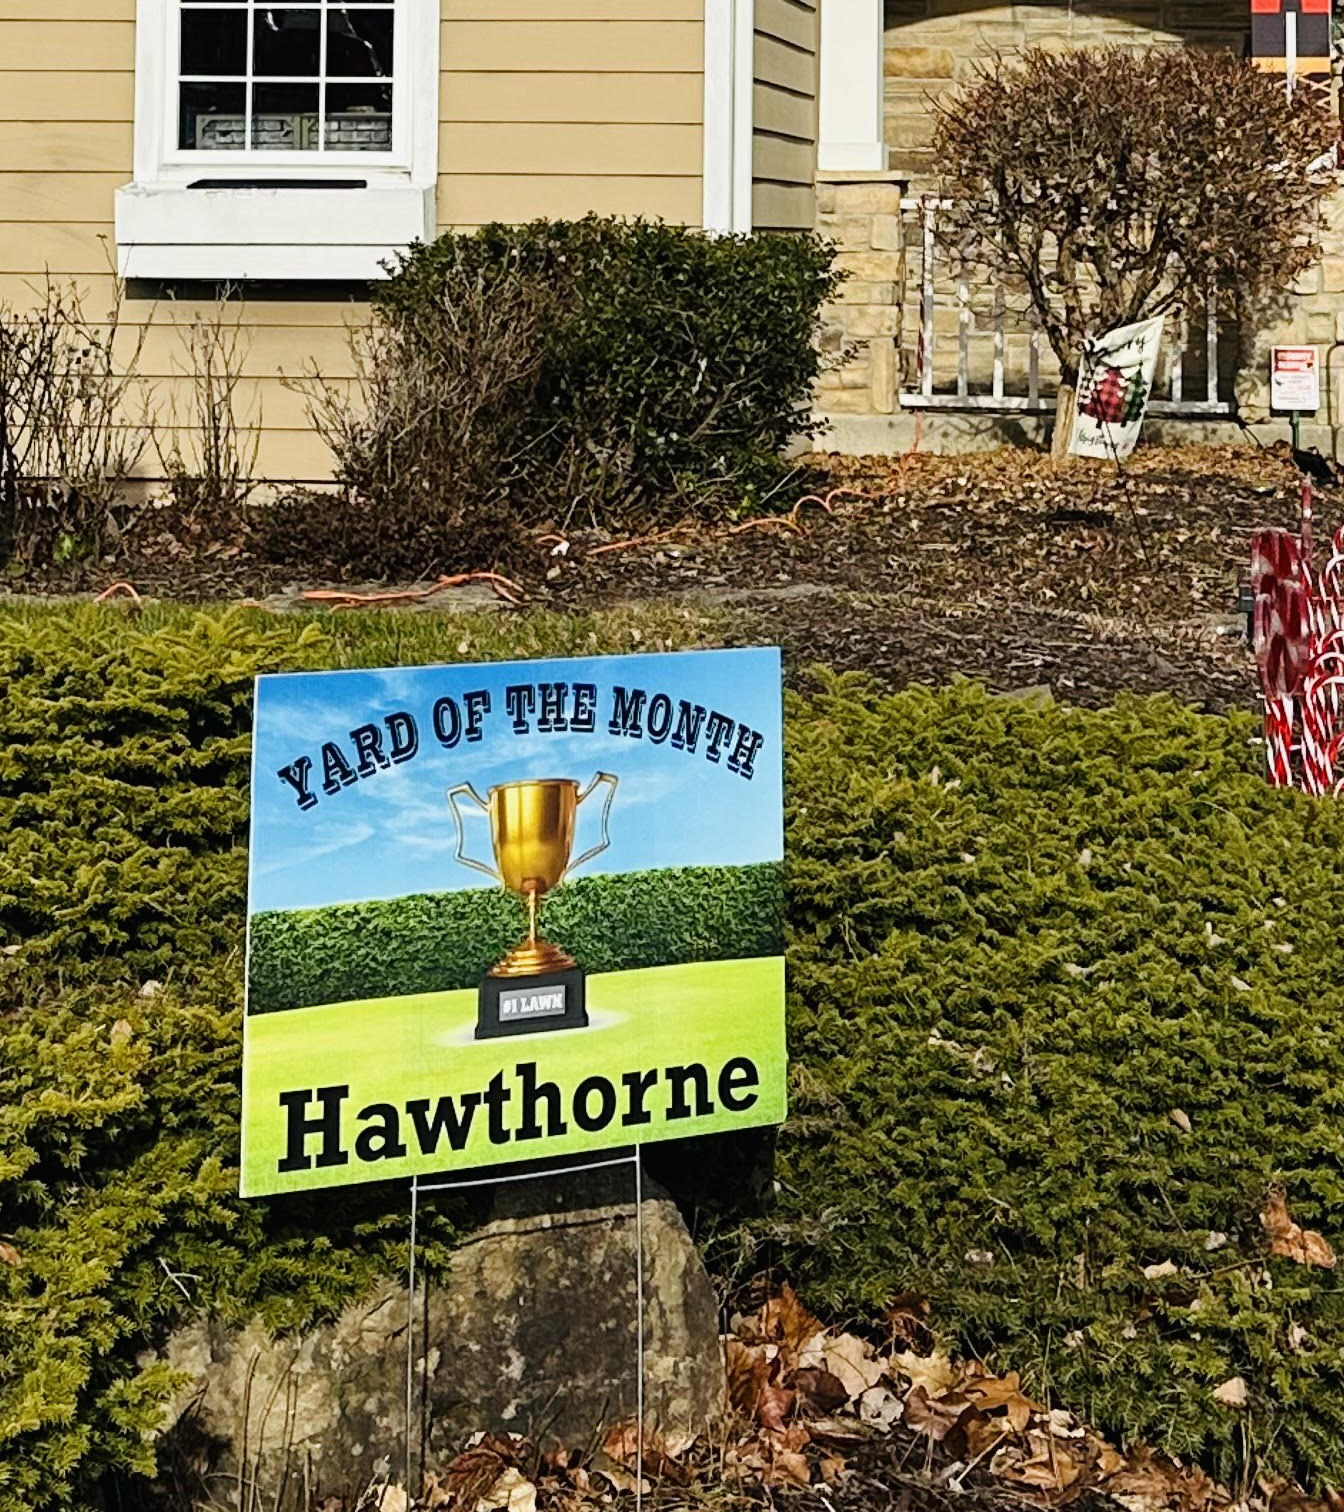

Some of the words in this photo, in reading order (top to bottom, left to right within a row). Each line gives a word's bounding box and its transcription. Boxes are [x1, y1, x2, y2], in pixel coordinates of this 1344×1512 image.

[277, 710, 419, 811] YARD
[432, 690, 491, 749] OF
[505, 682, 597, 735] THE
[608, 685, 765, 780] MONTH
[502, 998, 518, 1014] #1
[520, 993, 563, 1013] LAWN
[277, 1055, 760, 1174] Hawthorne
